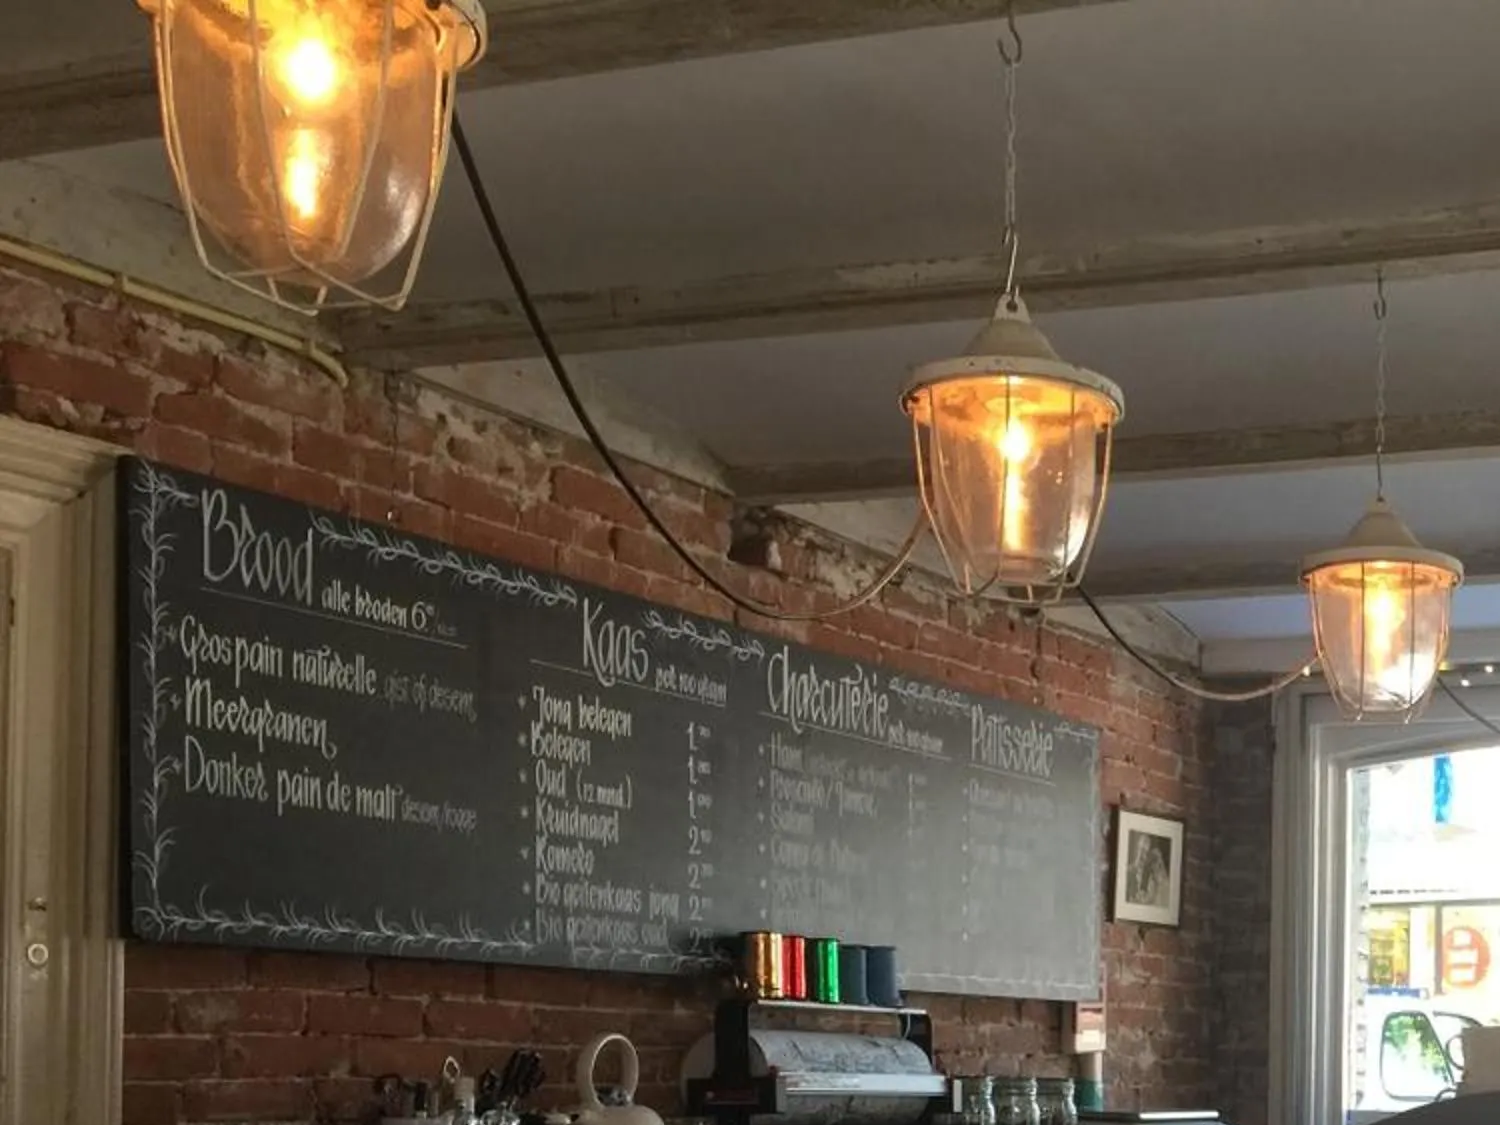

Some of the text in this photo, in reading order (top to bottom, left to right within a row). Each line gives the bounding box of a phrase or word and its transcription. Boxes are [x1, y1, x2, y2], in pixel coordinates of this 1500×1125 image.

[201, 487, 314, 606] Brood
[321, 579, 350, 616] alle
[354, 584, 408, 629] broden
[581, 597, 650, 688] Kaas
[185, 676, 337, 760] Meergranen
[531, 684, 571, 732] Jong
[577, 693, 633, 741] belegen
[767, 645, 889, 737] Charcuterie
[184, 735, 269, 801] Donker
[276, 767, 322, 816] pain
[326, 772, 351, 813] de
[531, 719, 591, 769] Belegen
[534, 758, 566, 799] Oud
